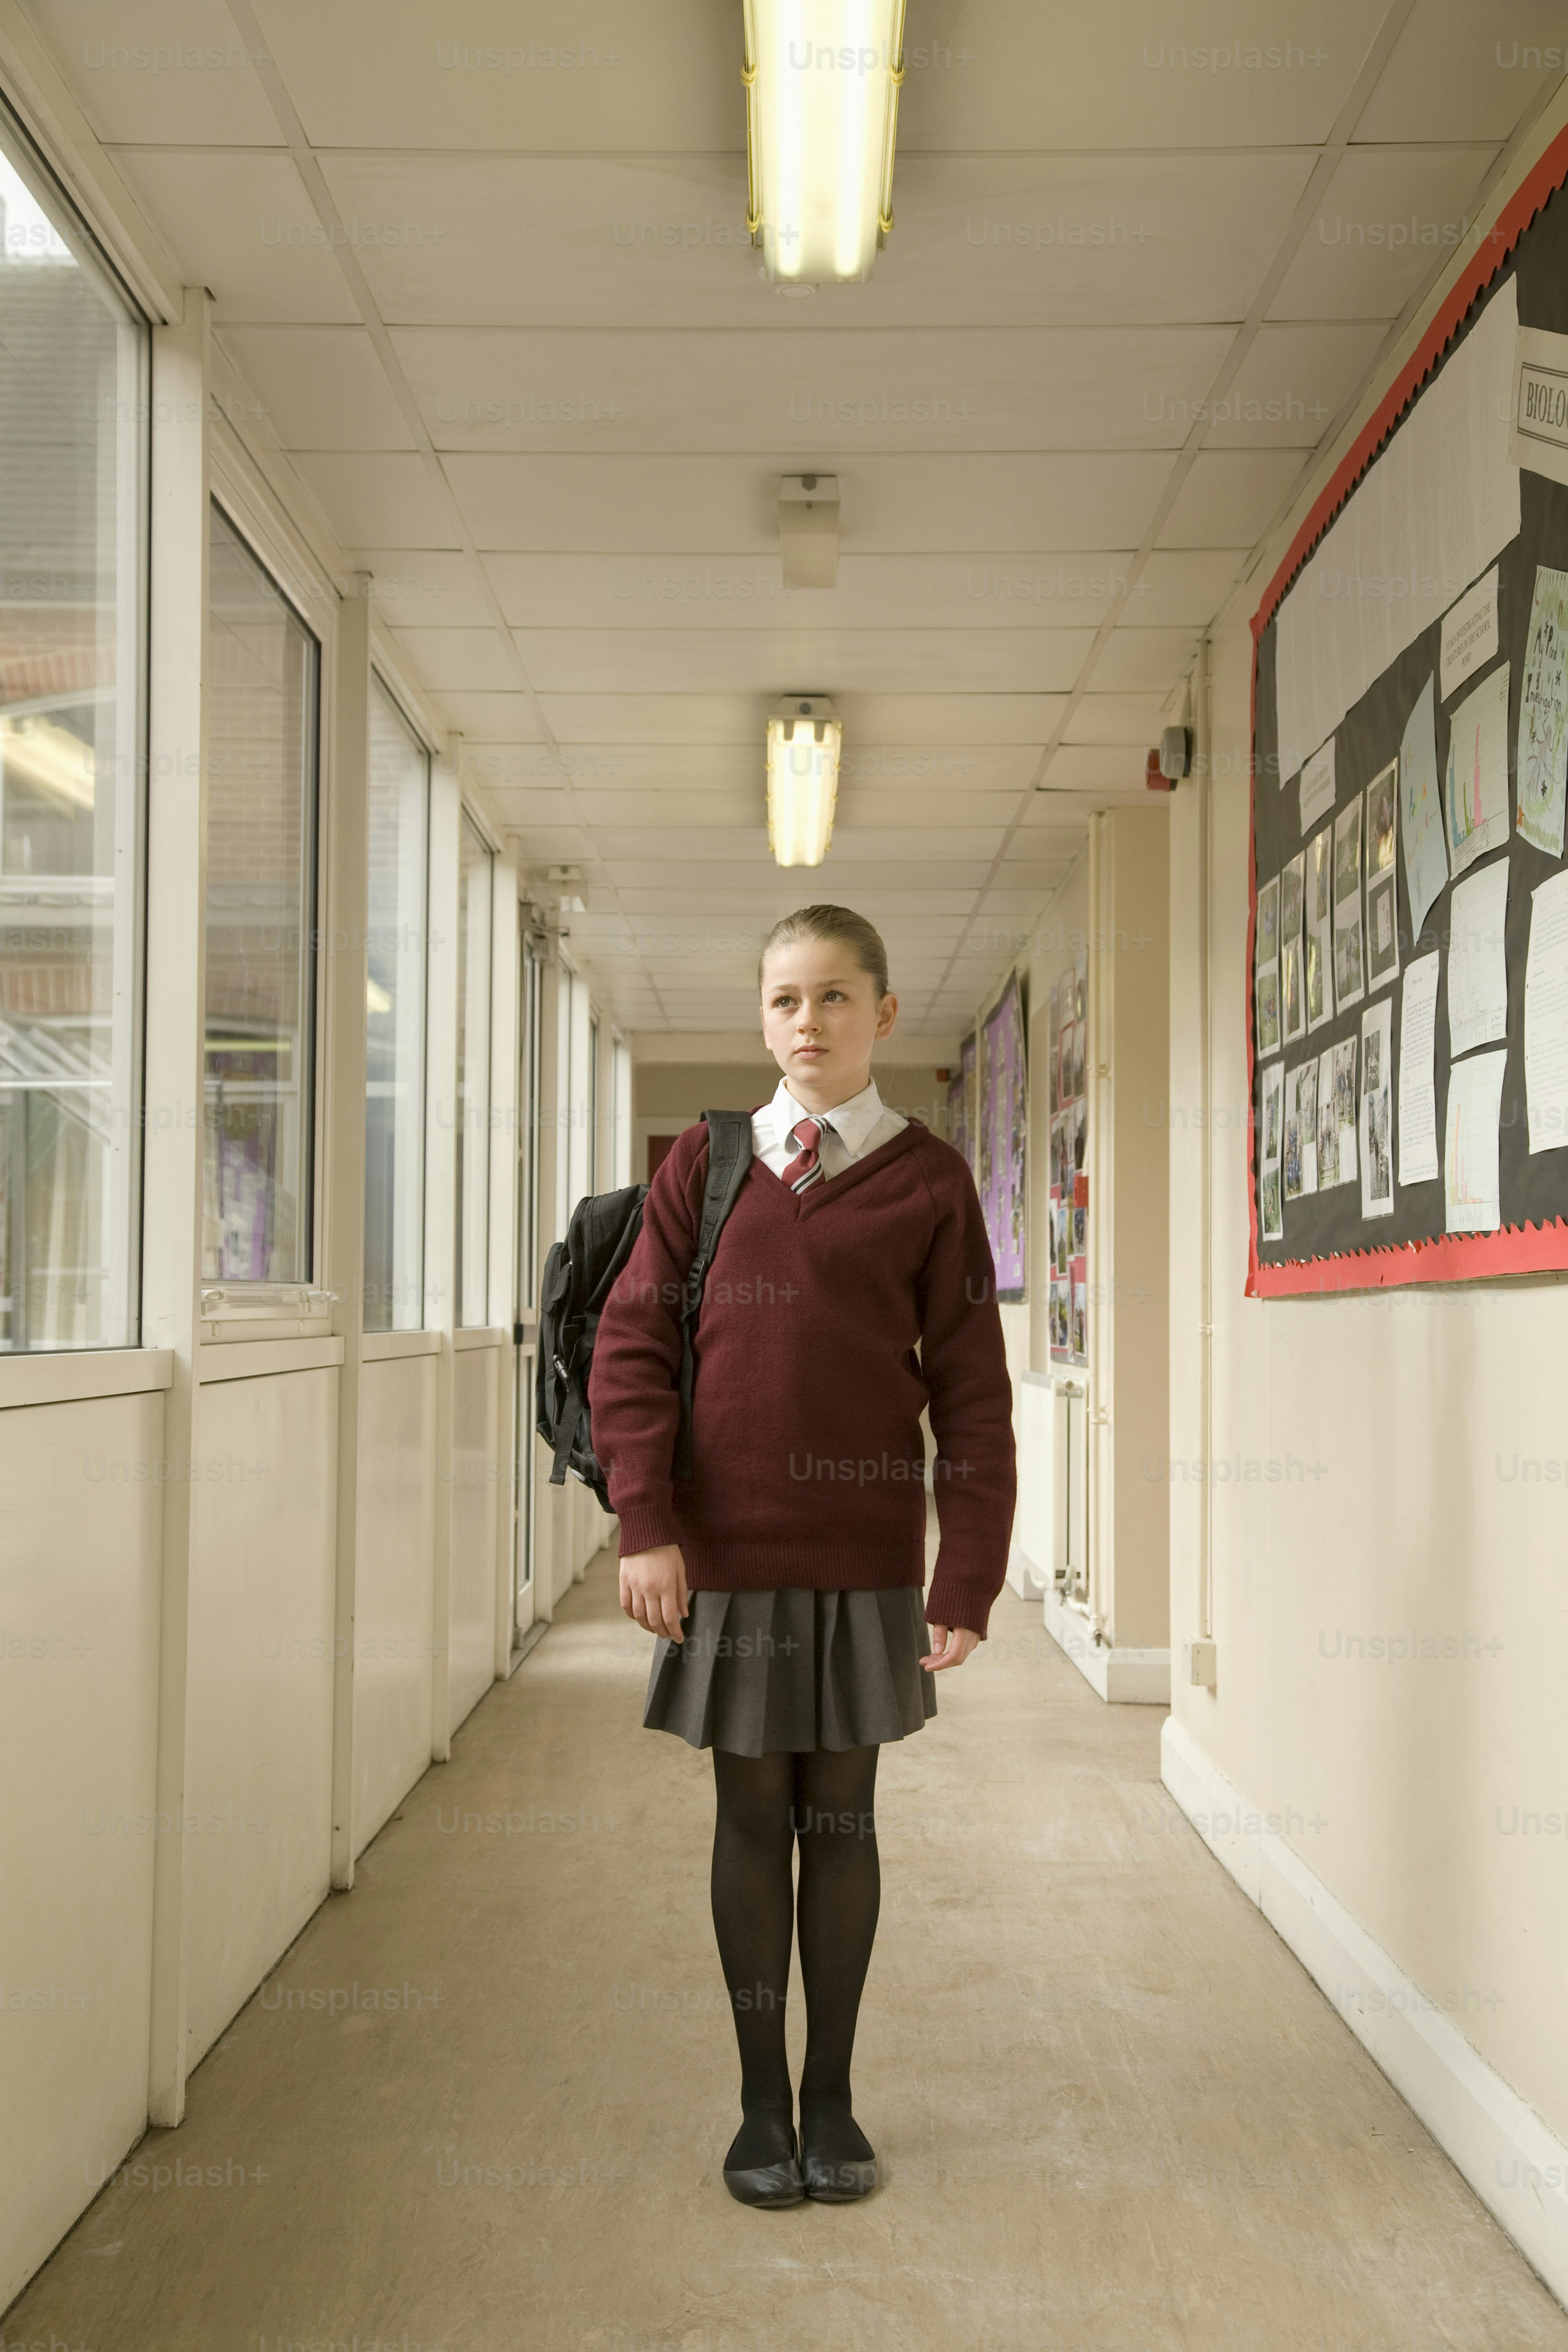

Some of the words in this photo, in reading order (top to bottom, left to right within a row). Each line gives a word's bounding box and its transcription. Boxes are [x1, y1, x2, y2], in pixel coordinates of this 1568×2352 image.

[1526, 381, 1568, 429] BIOLO
[1456, 608, 1483, 643] INVESTIGATING
[1475, 617, 1491, 641] SCHOOL
[1462, 651, 1471, 668] POND
[1534, 624, 1543, 669] My
[1546, 625, 1559, 661] Pond
[1526, 673, 1561, 715] Investigation
